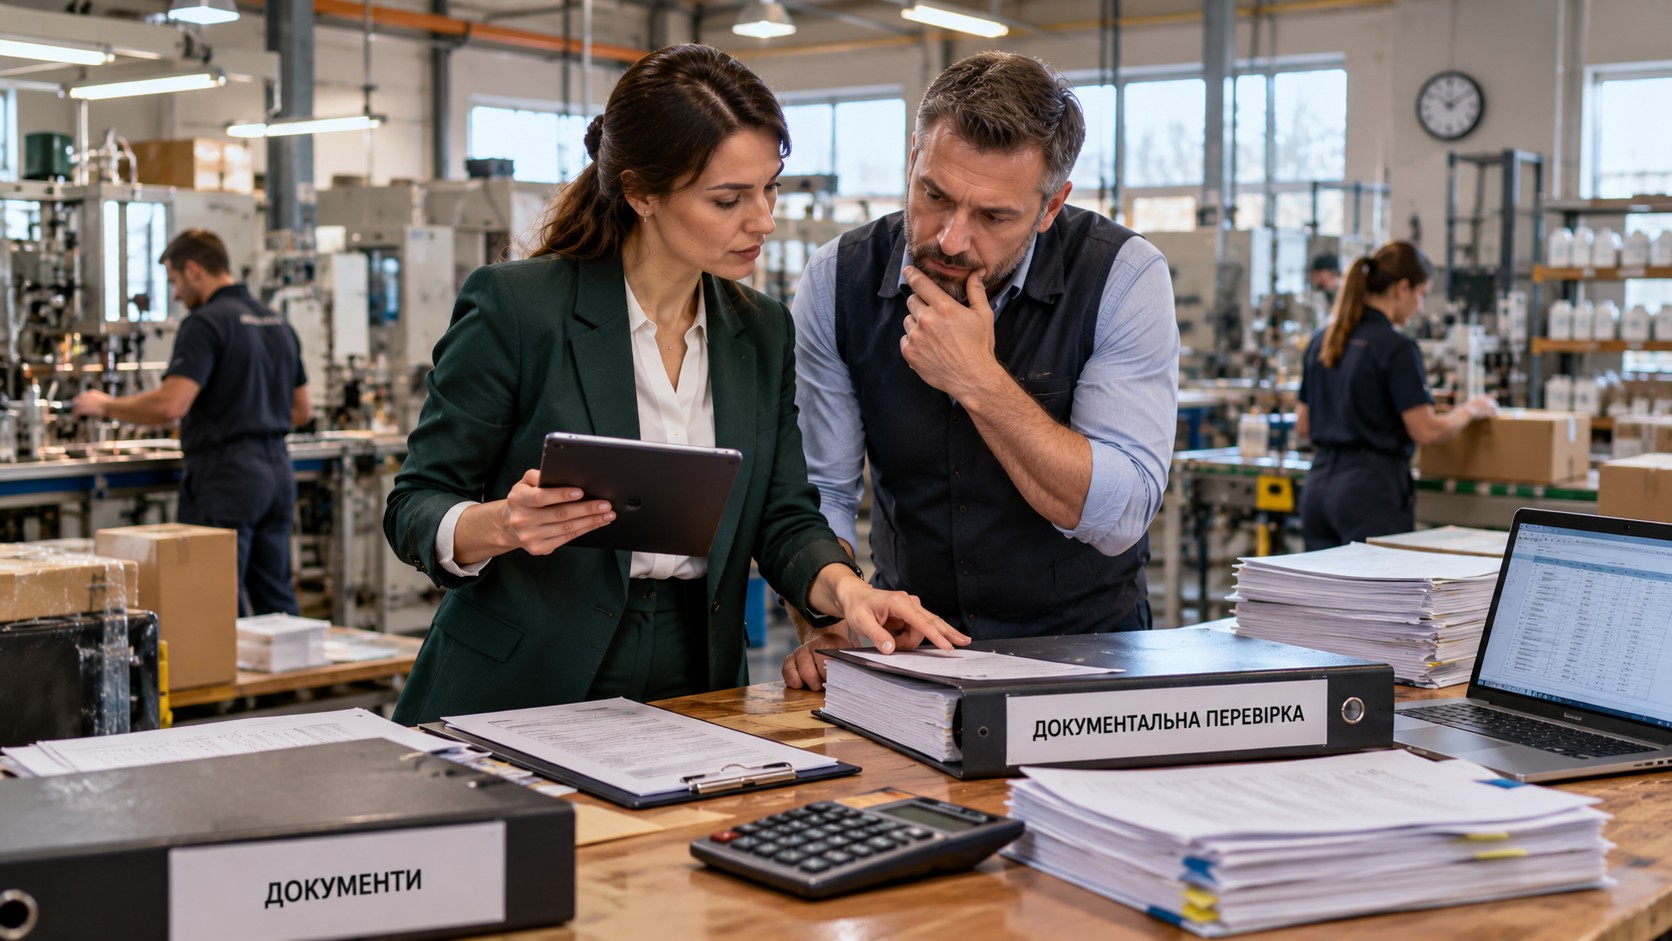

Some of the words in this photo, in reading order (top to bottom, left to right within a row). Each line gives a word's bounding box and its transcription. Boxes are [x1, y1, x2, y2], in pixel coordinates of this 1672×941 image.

[1032, 710, 1201, 742] ДОКУМЕНТАЛЬНА
[1206, 704, 1305, 728] ПЕРЕВІРКА
[264, 868, 422, 910] ДОКУМЕНТИ
